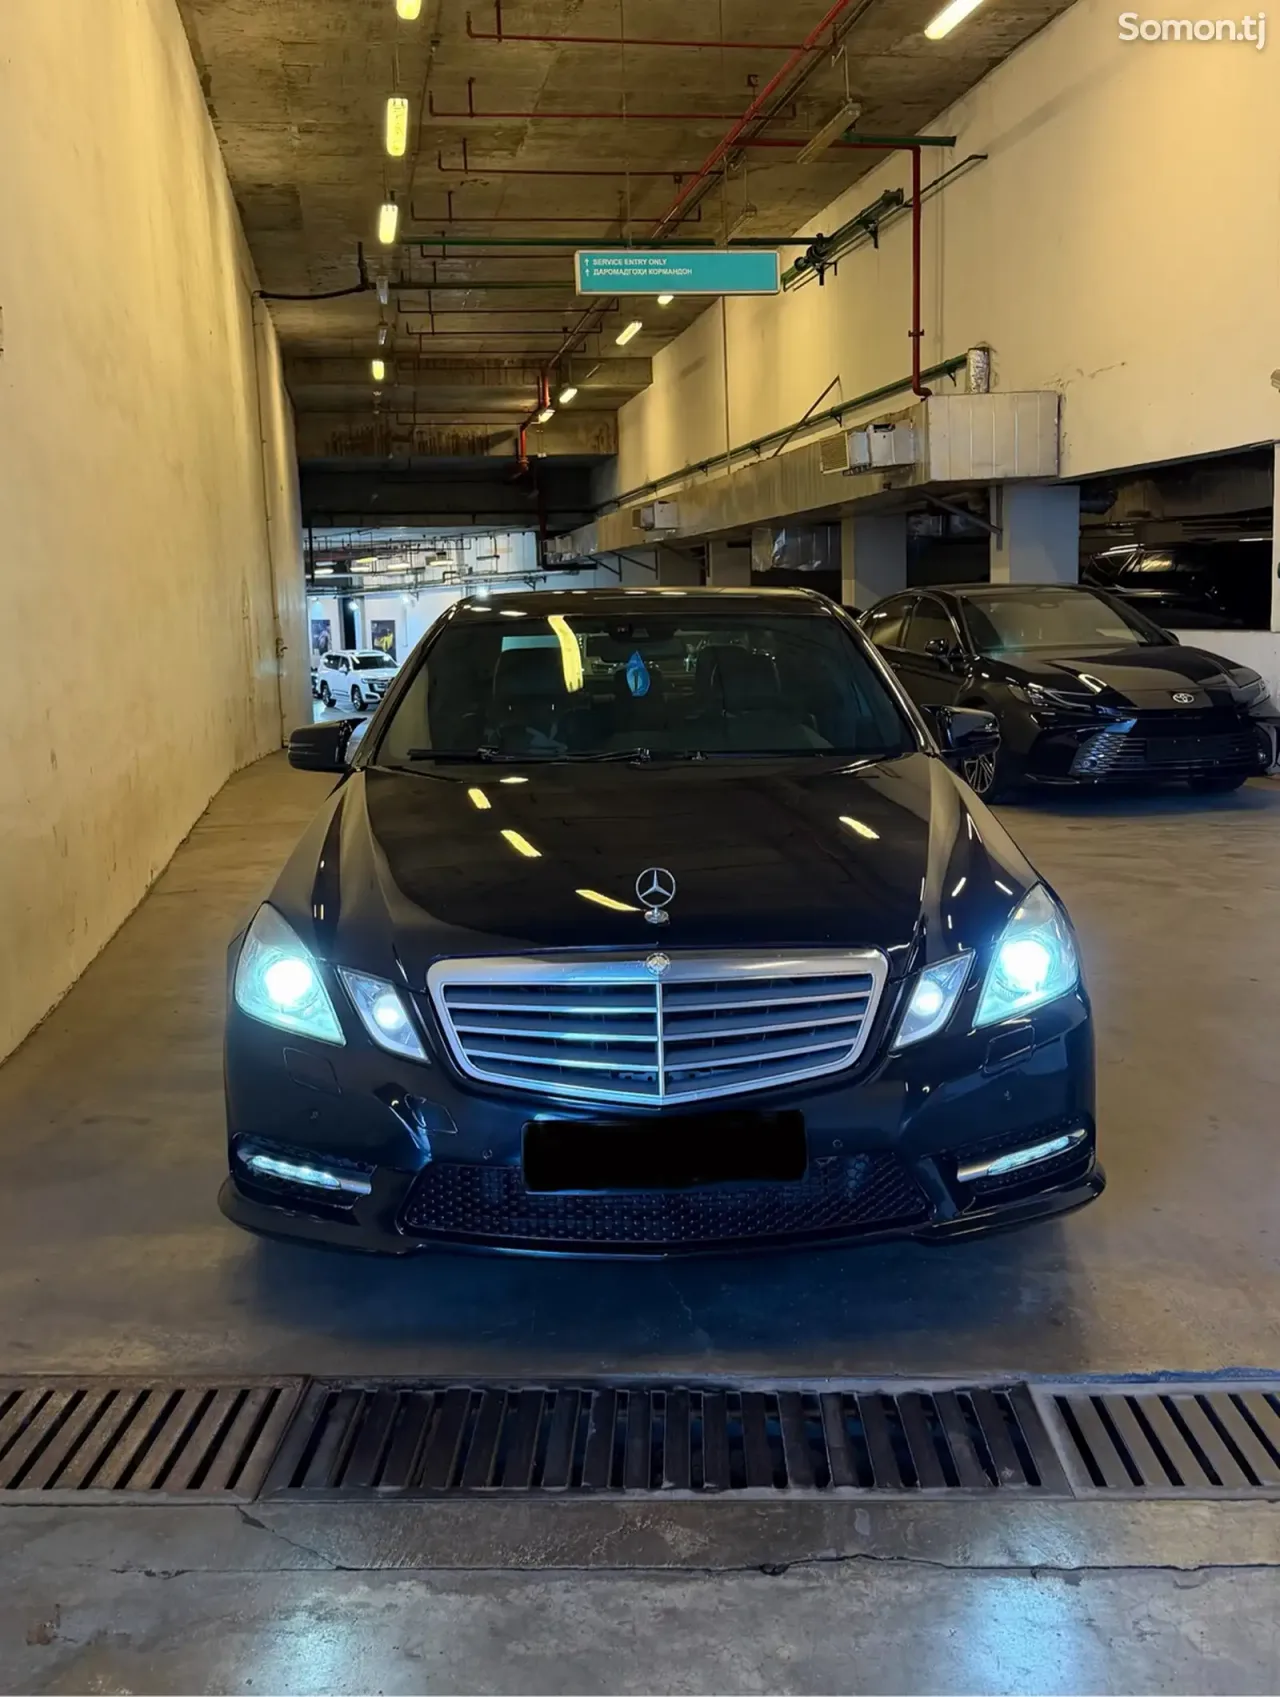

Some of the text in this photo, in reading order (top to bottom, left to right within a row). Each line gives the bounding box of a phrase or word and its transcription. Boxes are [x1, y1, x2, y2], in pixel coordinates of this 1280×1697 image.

[593, 258, 668, 266] SERVICE ENTRY ONLY
